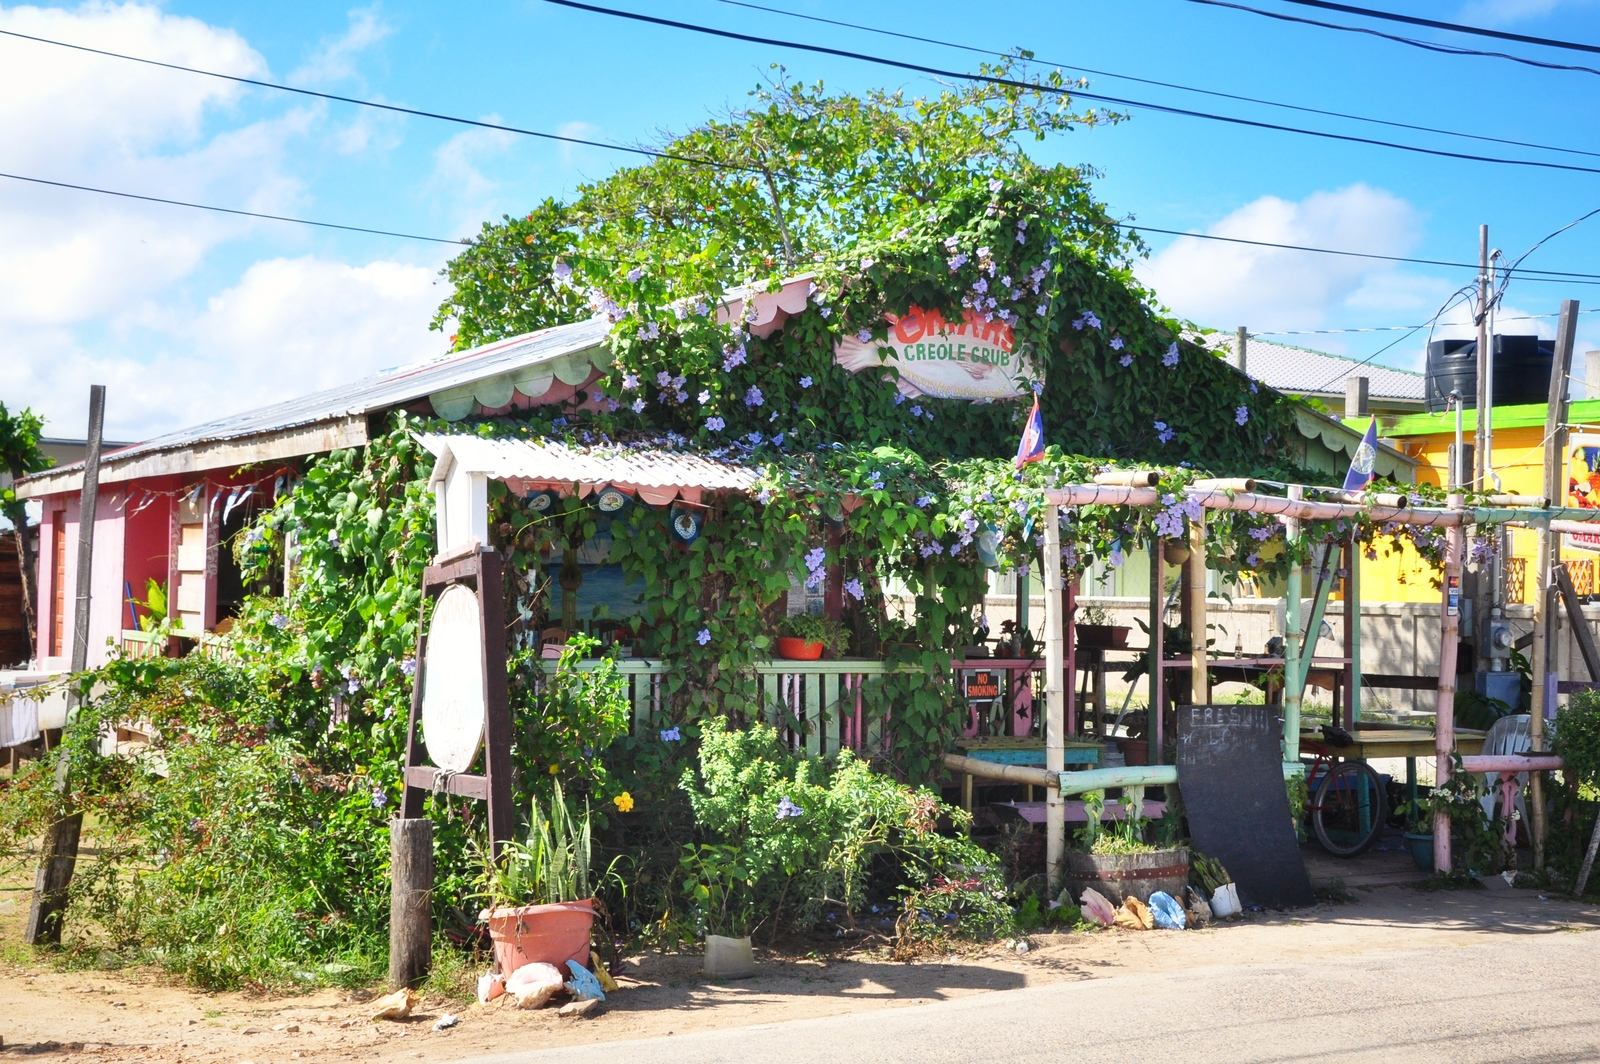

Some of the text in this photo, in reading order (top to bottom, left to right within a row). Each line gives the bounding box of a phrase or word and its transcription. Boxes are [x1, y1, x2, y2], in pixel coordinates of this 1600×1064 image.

[904, 343, 1010, 367] CREOLE GRUB
[977, 673, 988, 685] NO
[967, 685, 998, 697] SMOKING
